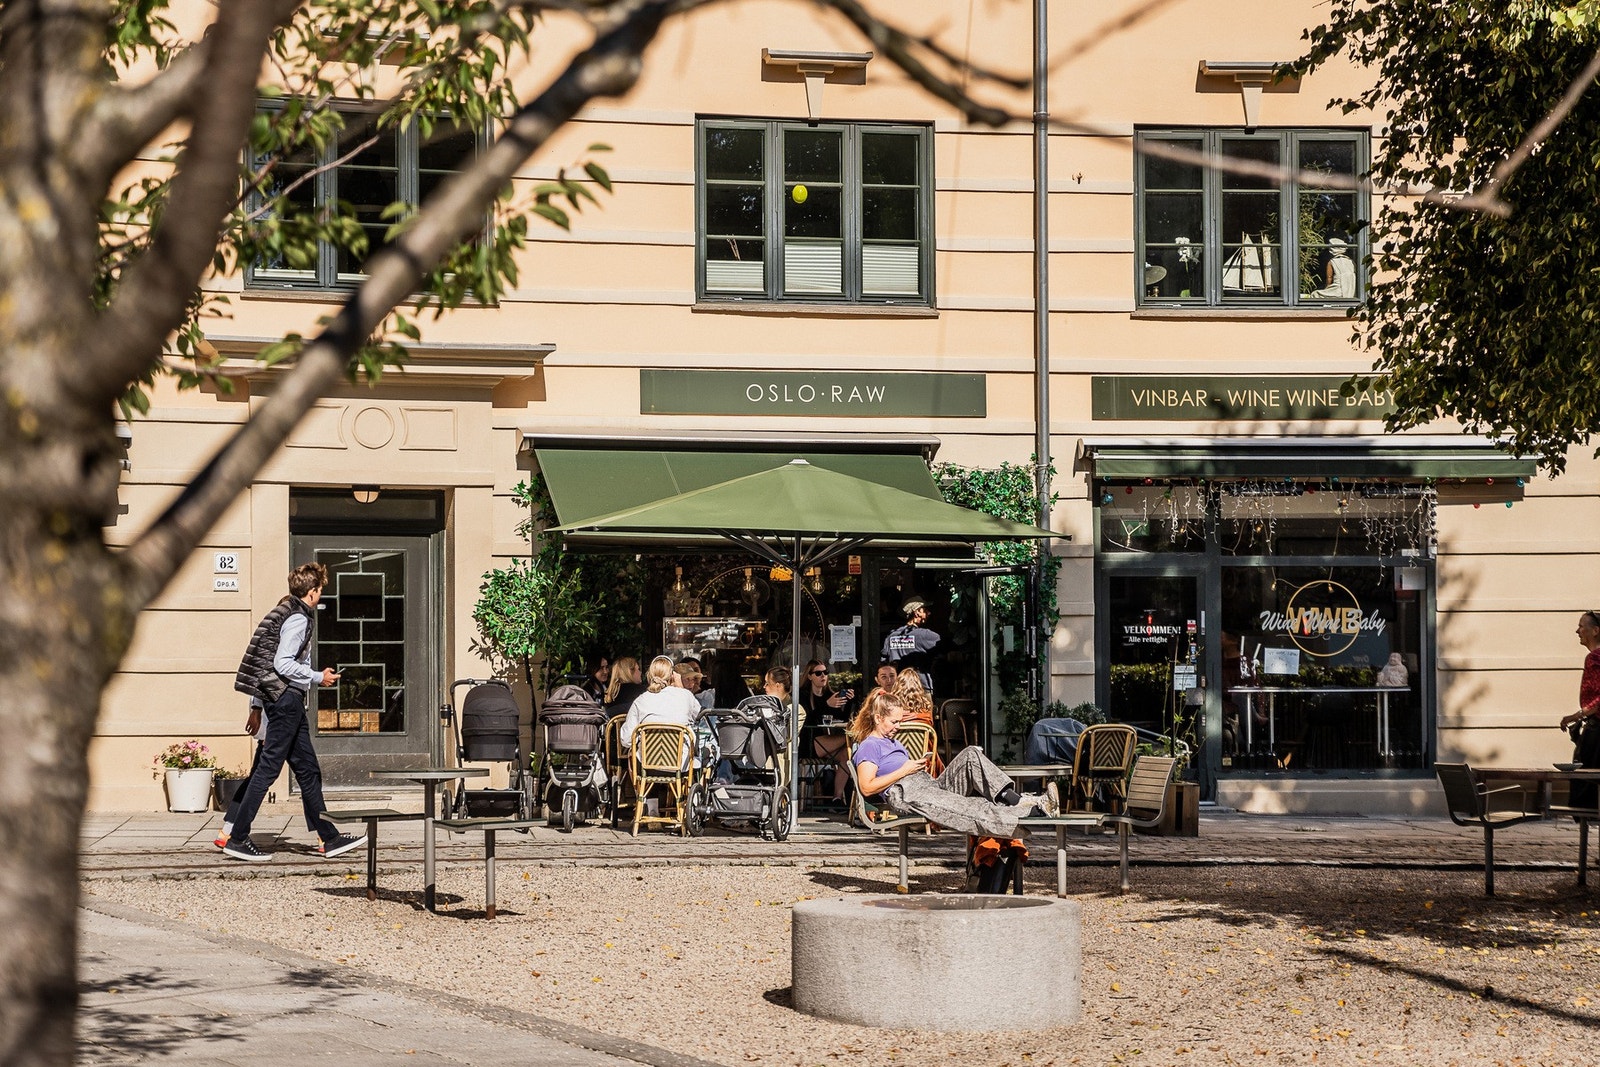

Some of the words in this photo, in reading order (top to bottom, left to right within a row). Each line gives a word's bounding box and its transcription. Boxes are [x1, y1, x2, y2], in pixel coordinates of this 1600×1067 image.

[745, 384, 815, 402] OSLO
[831, 385, 886, 403] RAW
[1131, 389, 1207, 407] VINBAR
[1227, 389, 1280, 407] WINE
[1286, 389, 1339, 407] WINE
[219, 556, 234, 569] 82
[1123, 626, 1181, 634] VELKOMMEN!
[1260, 610, 1298, 631] Wine
[1348, 608, 1386, 636] Baby
